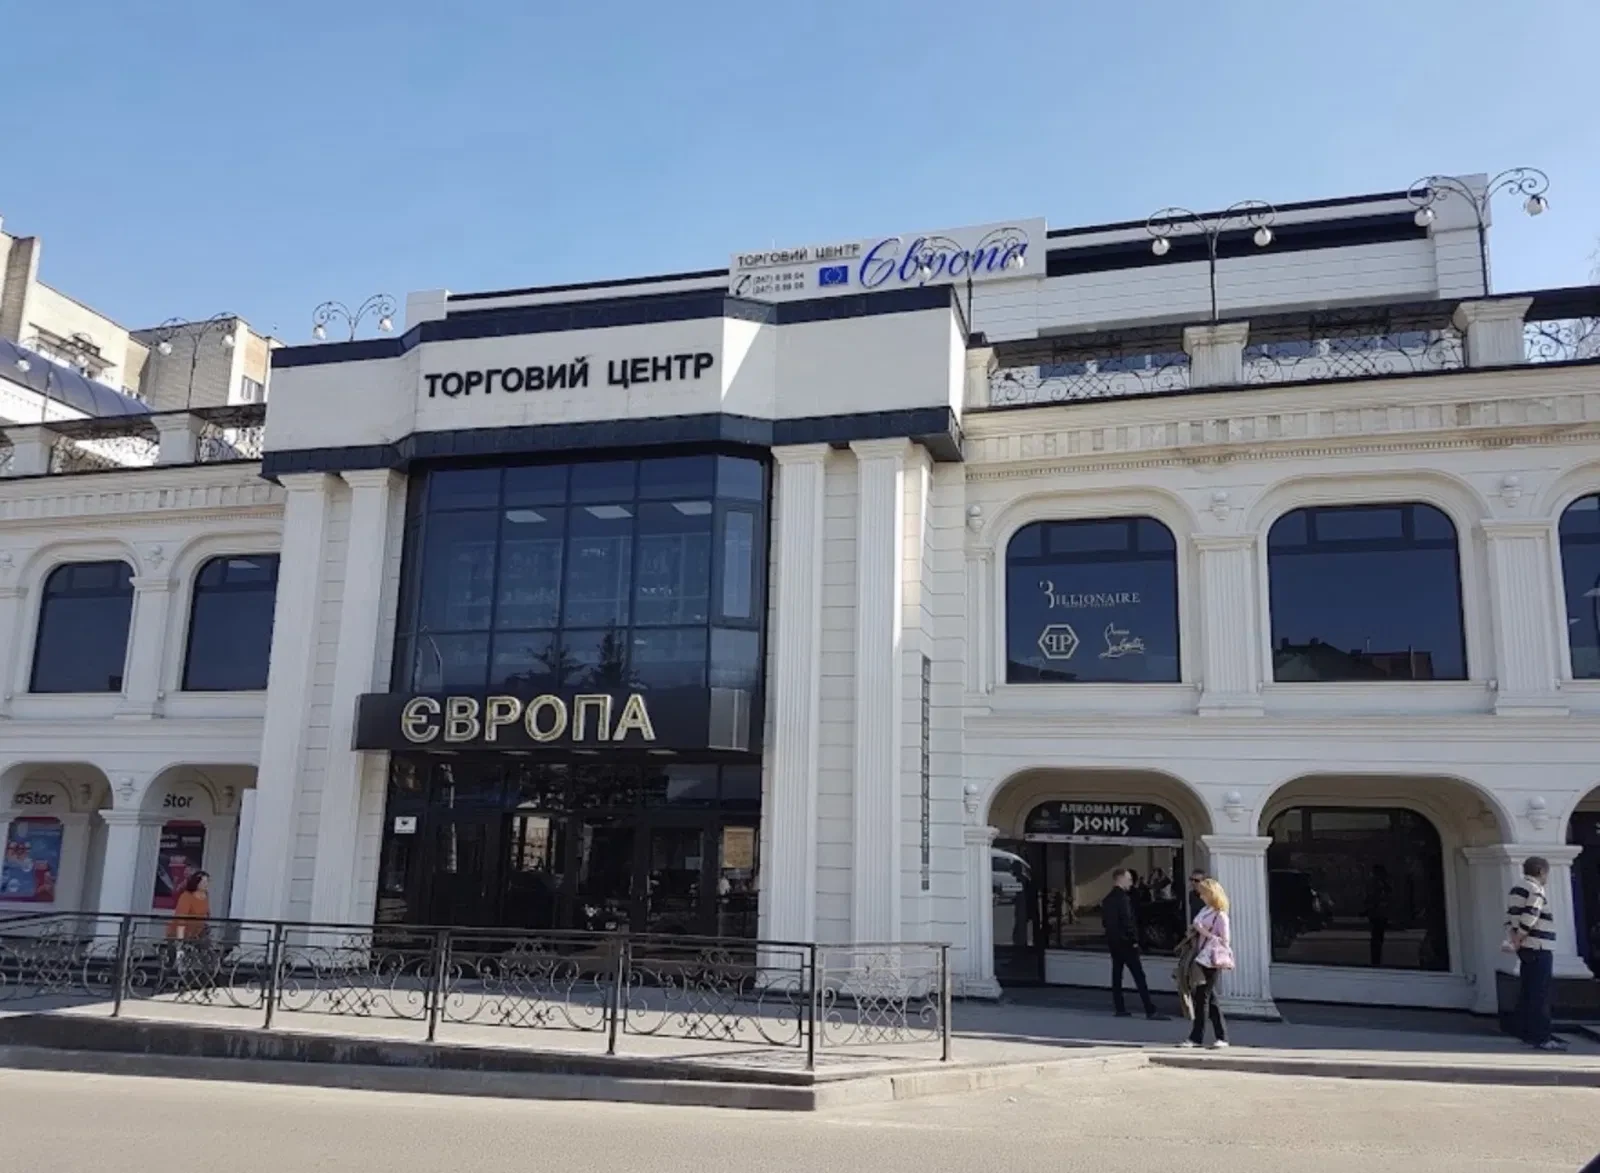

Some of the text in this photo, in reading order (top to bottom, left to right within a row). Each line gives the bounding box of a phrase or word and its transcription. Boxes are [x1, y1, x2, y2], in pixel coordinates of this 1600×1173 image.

[738, 244, 860, 267] ТОРГОВИЙ ЦЕНТР
[425, 352, 714, 398] ТОРГОВИЙ ЦЕНТР
[401, 693, 656, 743] ЄВРОПА
[1060, 803, 1143, 816] АЛКОМАРКЕТ
[1072, 815, 1130, 835] DIONIS
